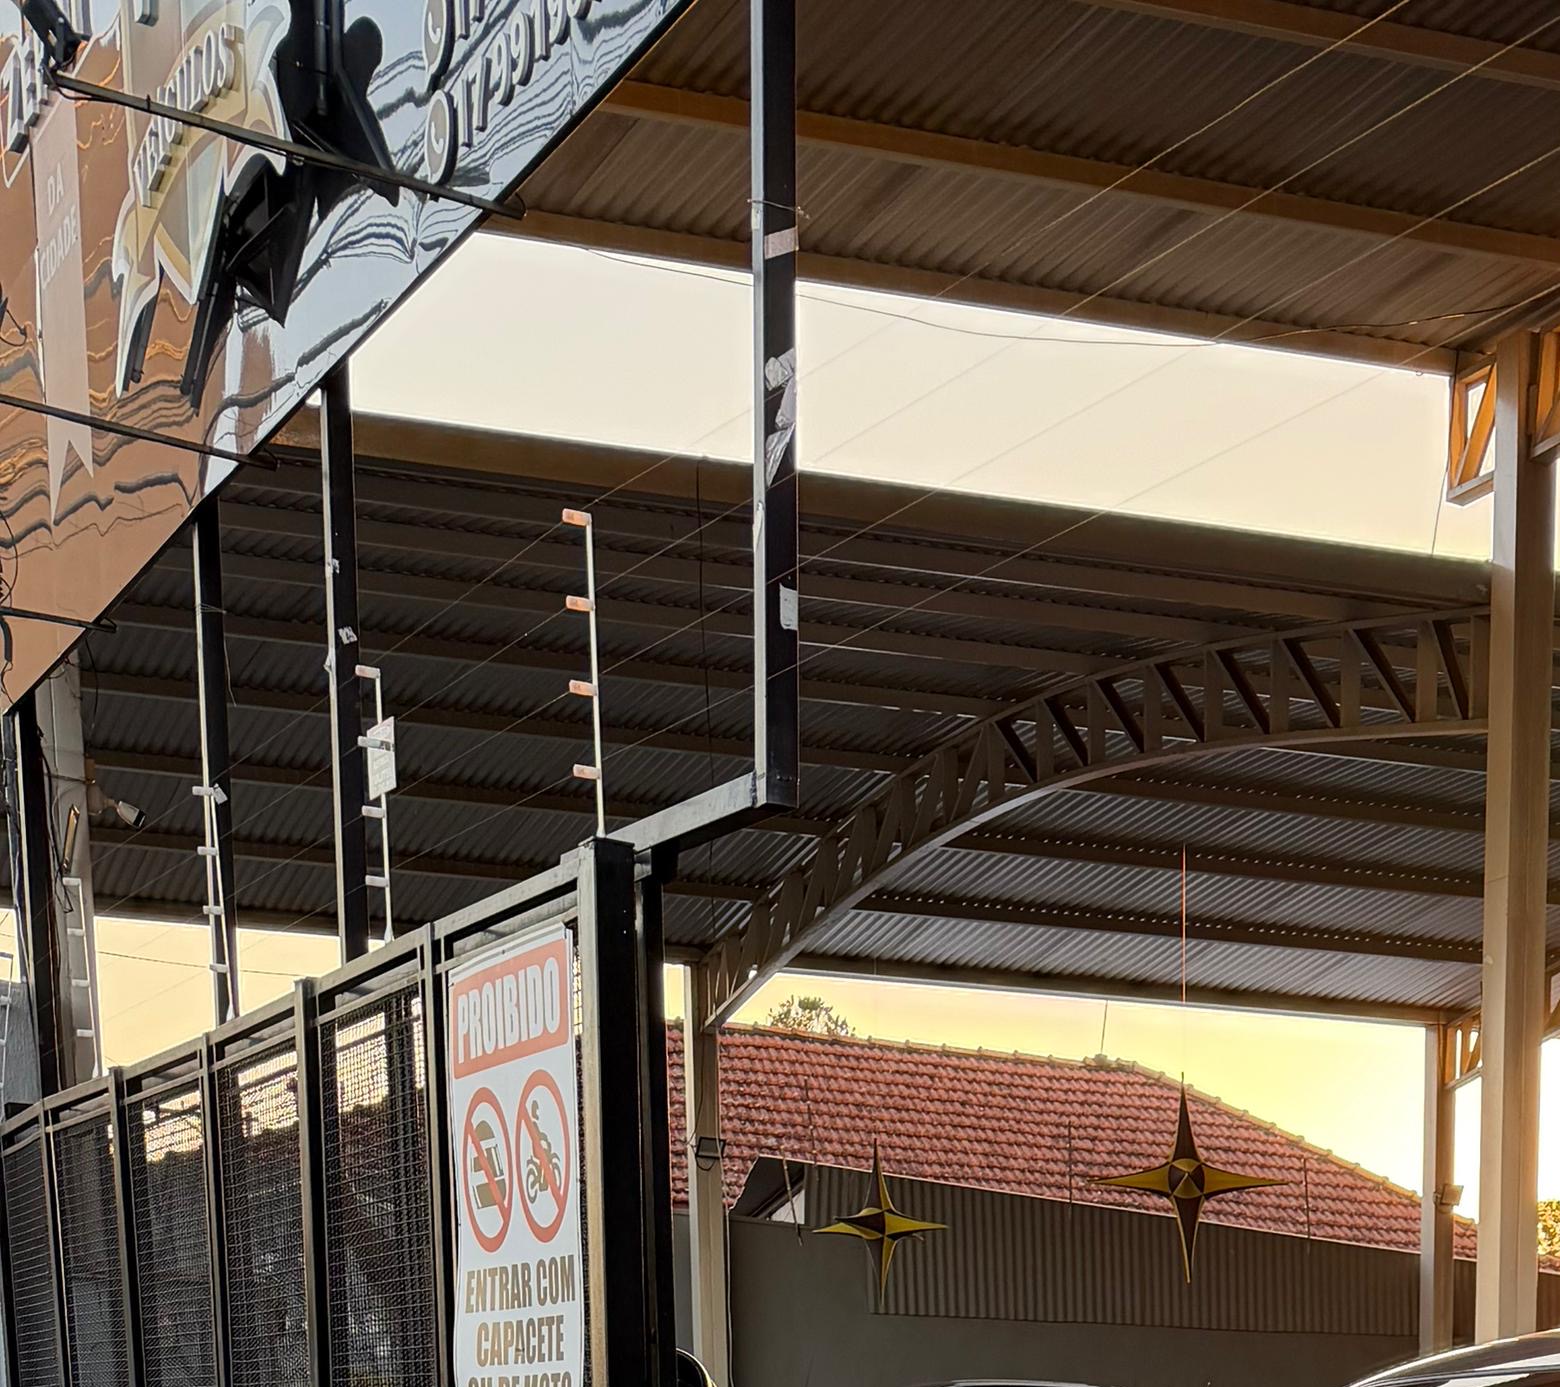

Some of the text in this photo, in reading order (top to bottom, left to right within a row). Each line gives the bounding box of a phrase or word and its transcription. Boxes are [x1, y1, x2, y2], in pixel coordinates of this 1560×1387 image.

[47, 162, 64, 217] DA
[41, 204, 77, 290] CIDADE
[457, 956, 561, 1064] PROIBIDO
[465, 1254, 576, 1314] ENTRAR COM
[476, 1315, 564, 1367] CAPACETE
